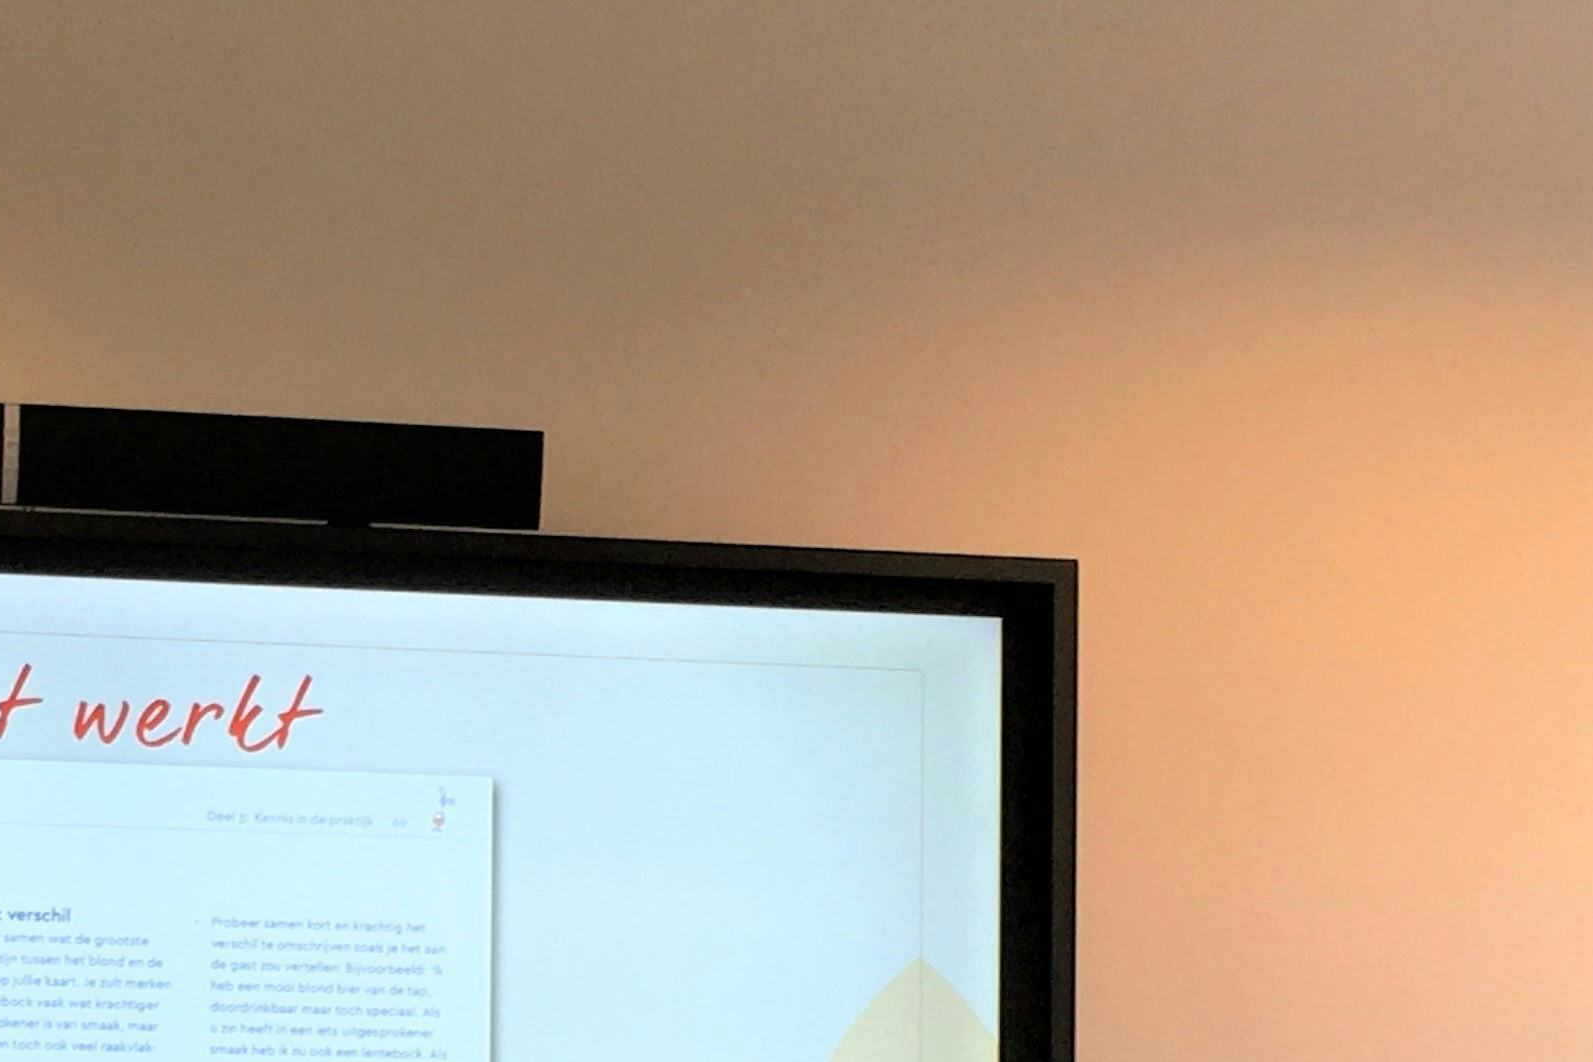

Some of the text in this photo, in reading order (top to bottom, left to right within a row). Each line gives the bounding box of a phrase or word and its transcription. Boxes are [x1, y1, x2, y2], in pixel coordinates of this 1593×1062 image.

[73, 674, 323, 752] werkt
[207, 810, 235, 822] Deel
[254, 812, 293, 824] Kennis
[310, 813, 325, 825] de
[327, 814, 373, 829] praktijk
[8, 907, 71, 923] verschil
[335, 921, 349, 931] en
[75, 933, 91, 945] de
